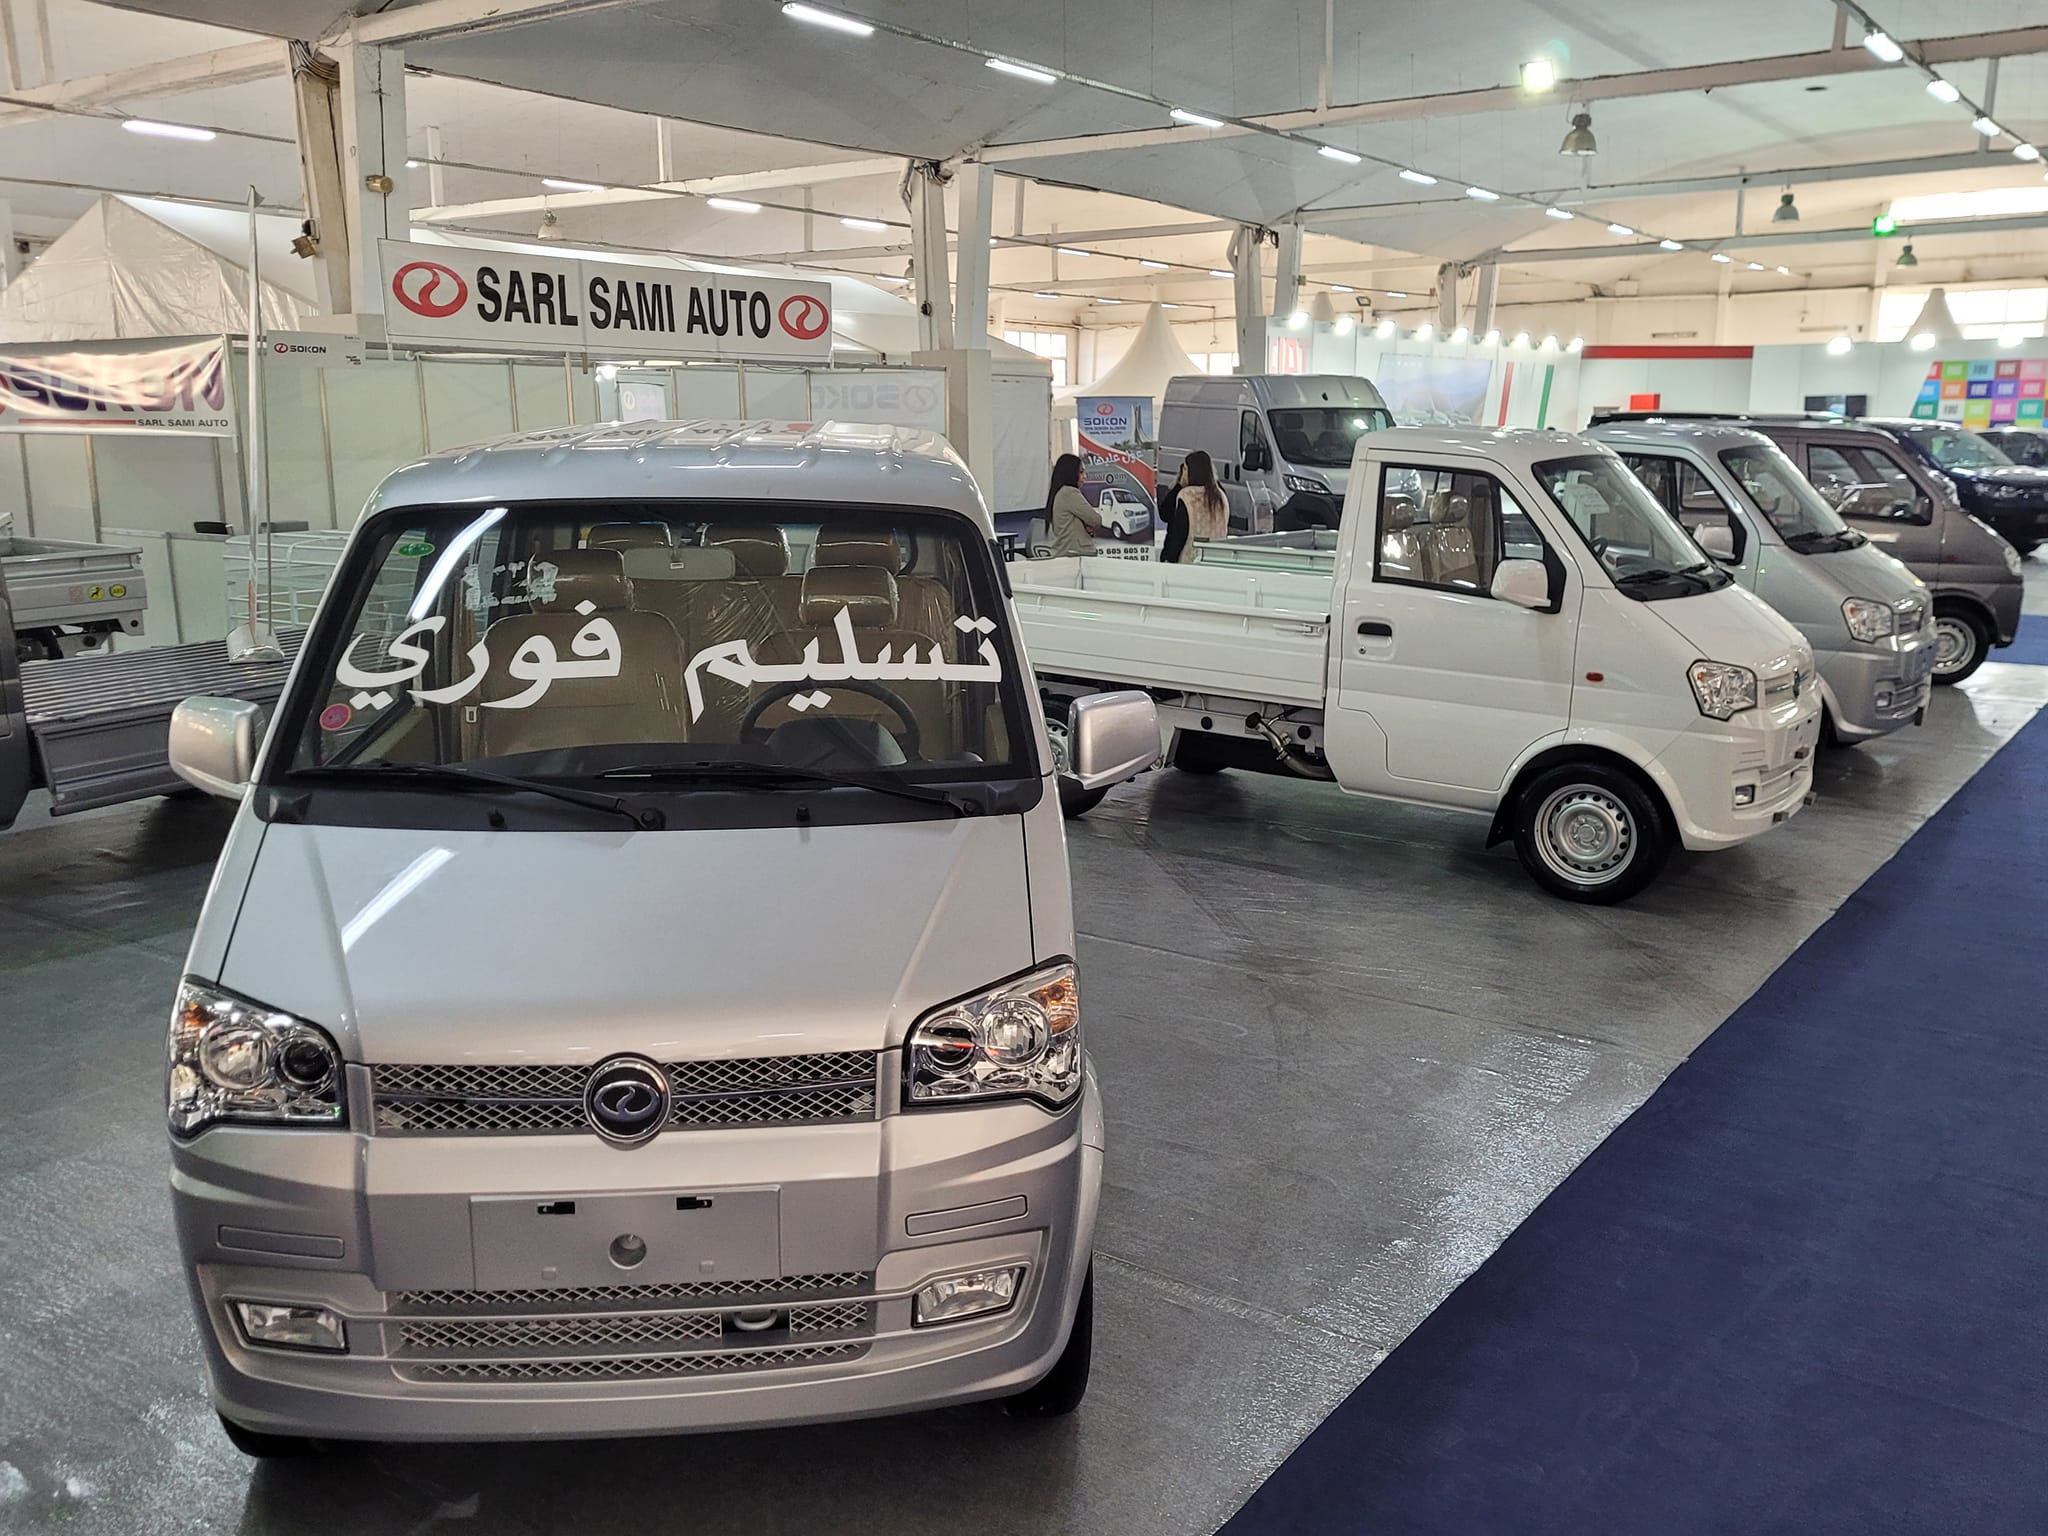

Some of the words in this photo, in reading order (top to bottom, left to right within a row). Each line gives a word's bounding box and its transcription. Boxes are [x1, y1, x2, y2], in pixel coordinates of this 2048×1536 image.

[477, 266, 579, 327] SARL
[589, 276, 676, 333] SAMI
[687, 287, 771, 339] AUTO
[289, 345, 327, 354] SOKON
[138, 418, 163, 427] SARL
[167, 419, 195, 427] SAMI
[198, 419, 229, 428] AUTO
[1084, 417, 1127, 426] SOKON
[336, 599, 622, 711] فوري
[684, 605, 1002, 725] تسليم
